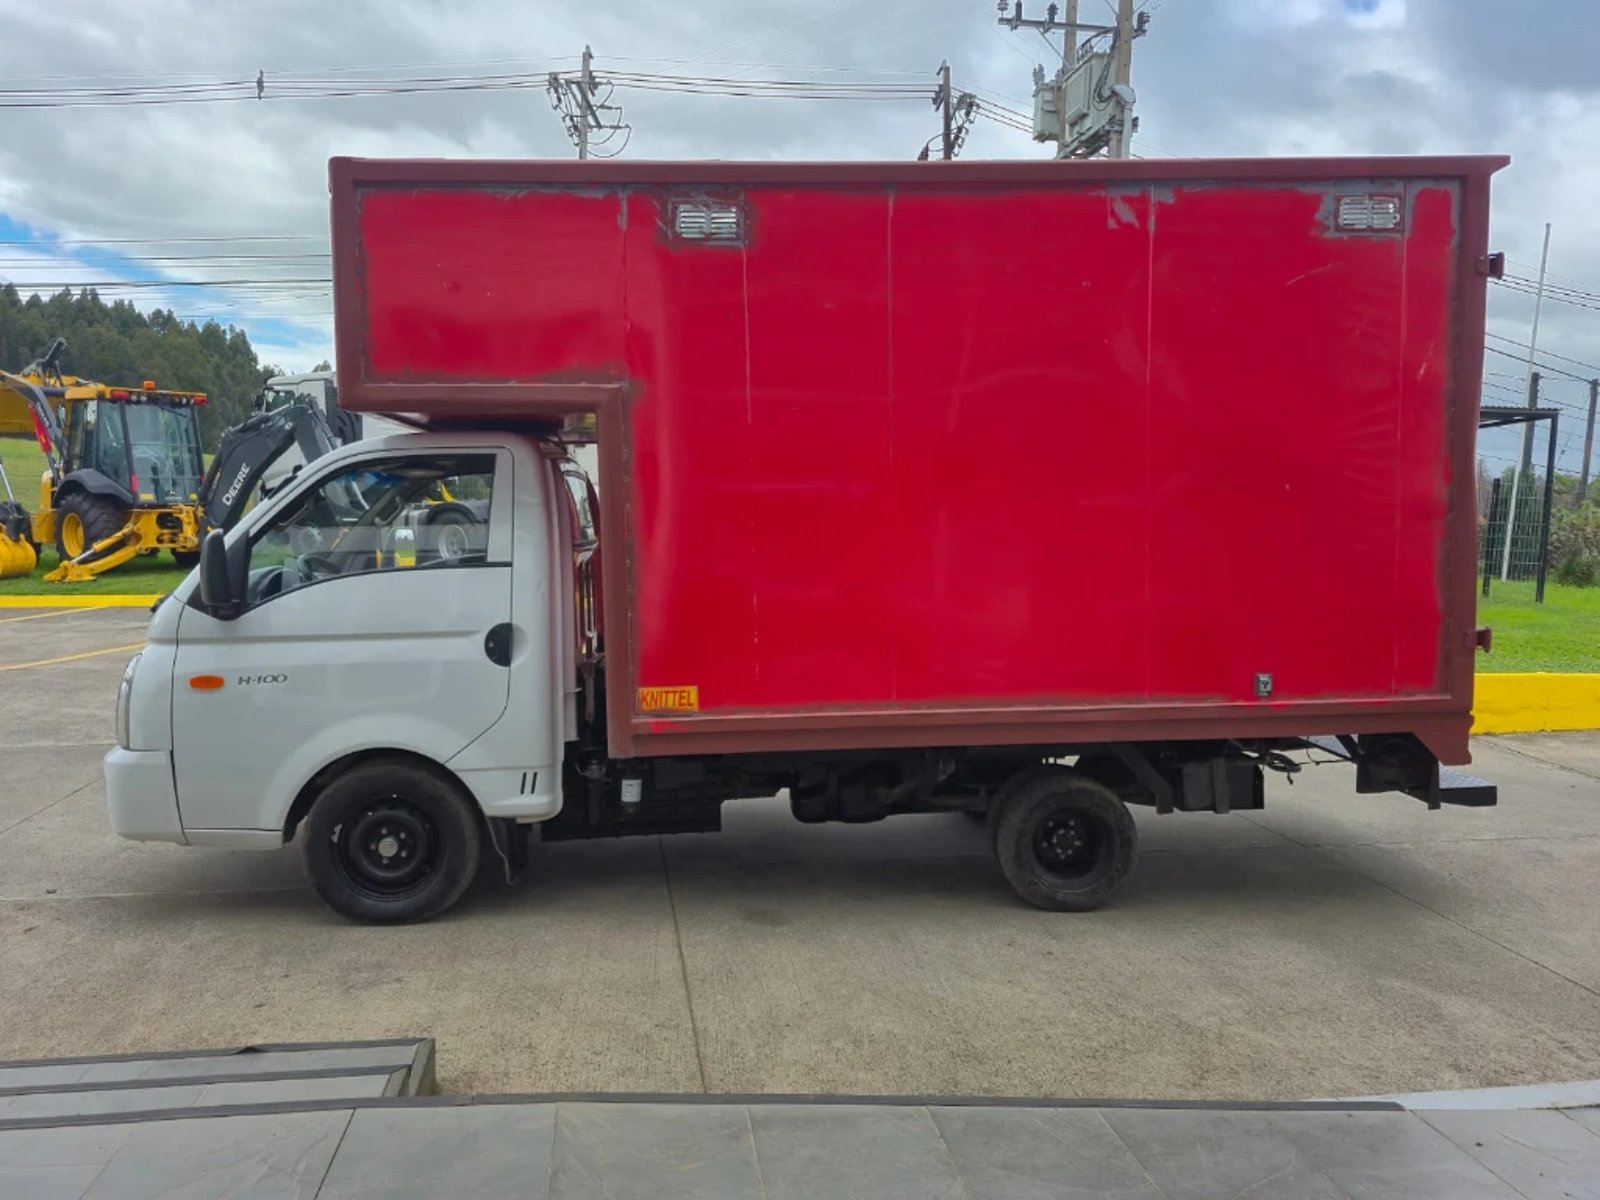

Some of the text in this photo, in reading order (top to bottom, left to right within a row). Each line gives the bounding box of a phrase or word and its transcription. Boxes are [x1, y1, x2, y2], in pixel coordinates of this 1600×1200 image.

[222, 462, 251, 506] DEERE
[238, 673, 288, 685] H-100
[641, 689, 695, 707] KNITTEL
